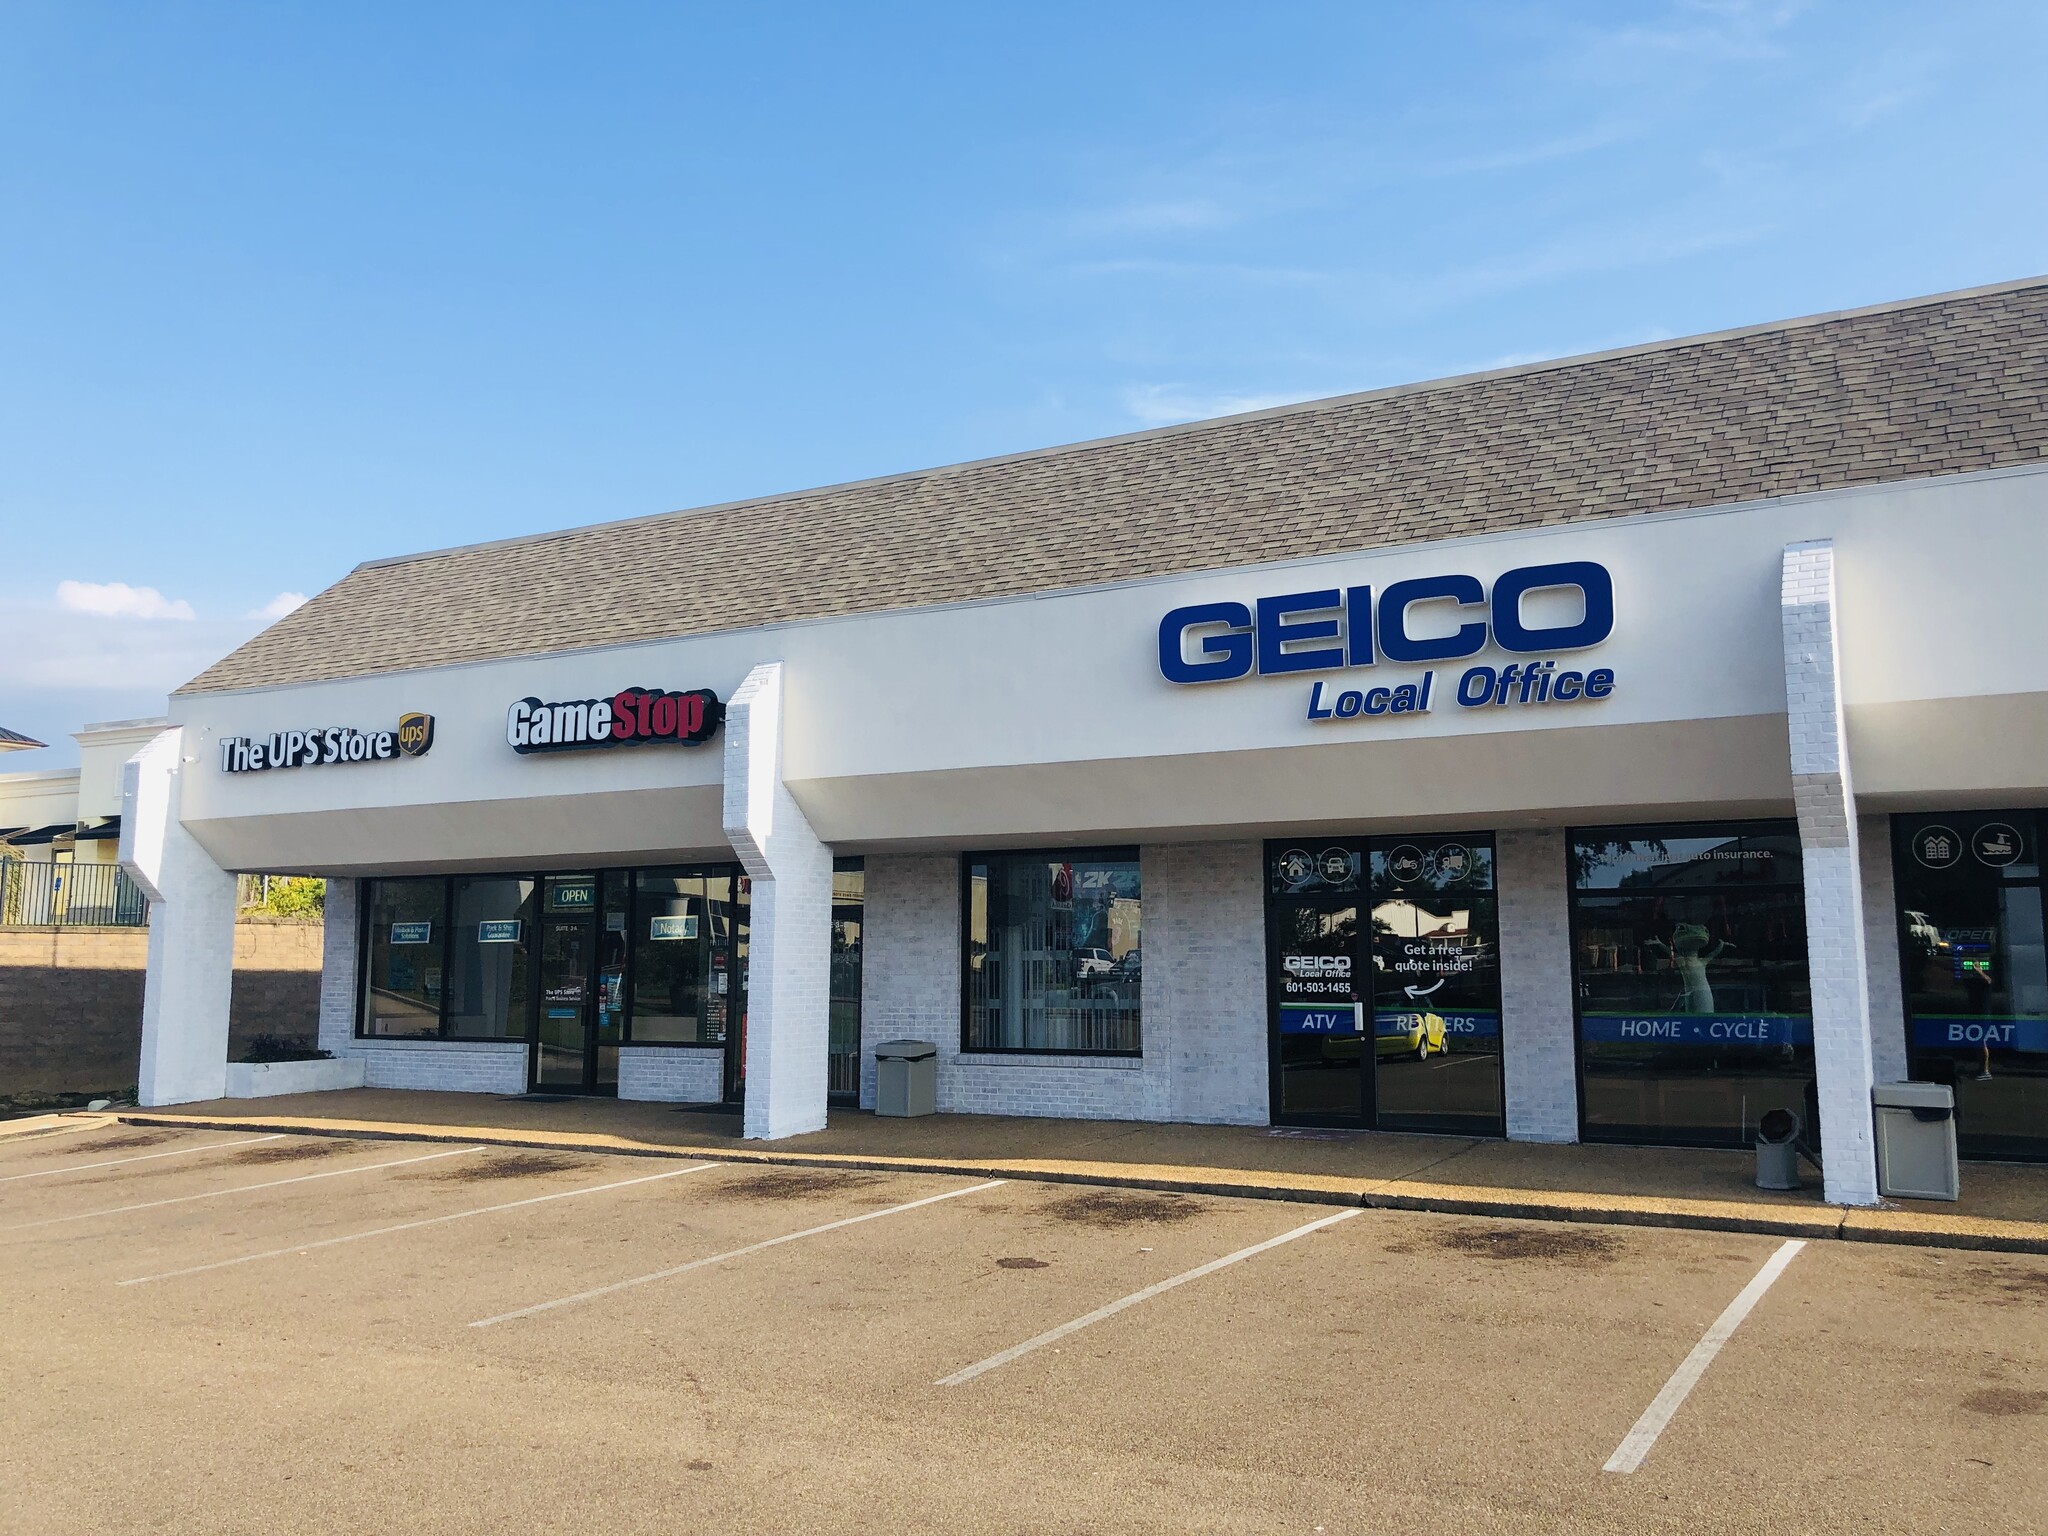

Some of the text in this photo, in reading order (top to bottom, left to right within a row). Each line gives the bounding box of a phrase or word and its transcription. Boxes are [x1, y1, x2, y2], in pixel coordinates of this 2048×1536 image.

[1158, 561, 1615, 685] GEICO
[1306, 660, 1615, 721] Local Office
[506, 691, 704, 747] GameStop
[400, 724, 424, 749] ups
[220, 726, 393, 772] The UPS Store
[1713, 849, 1774, 860] insurance.
[561, 889, 588, 902] OPEN
[1947, 930, 1994, 940] OPEN
[1404, 943, 1463, 955] Get a free
[1285, 955, 1351, 970] GEICO
[1395, 960, 1473, 973] quote inside!
[1299, 969, 1352, 978] Local Office
[1286, 982, 1351, 993] 601-503-1455
[1301, 1013, 1338, 1030] ATV
[1396, 1015, 1475, 1032] REERS
[1621, 1020, 1769, 1039] HOME CYCLE
[1948, 1023, 2016, 1042] BOAT
